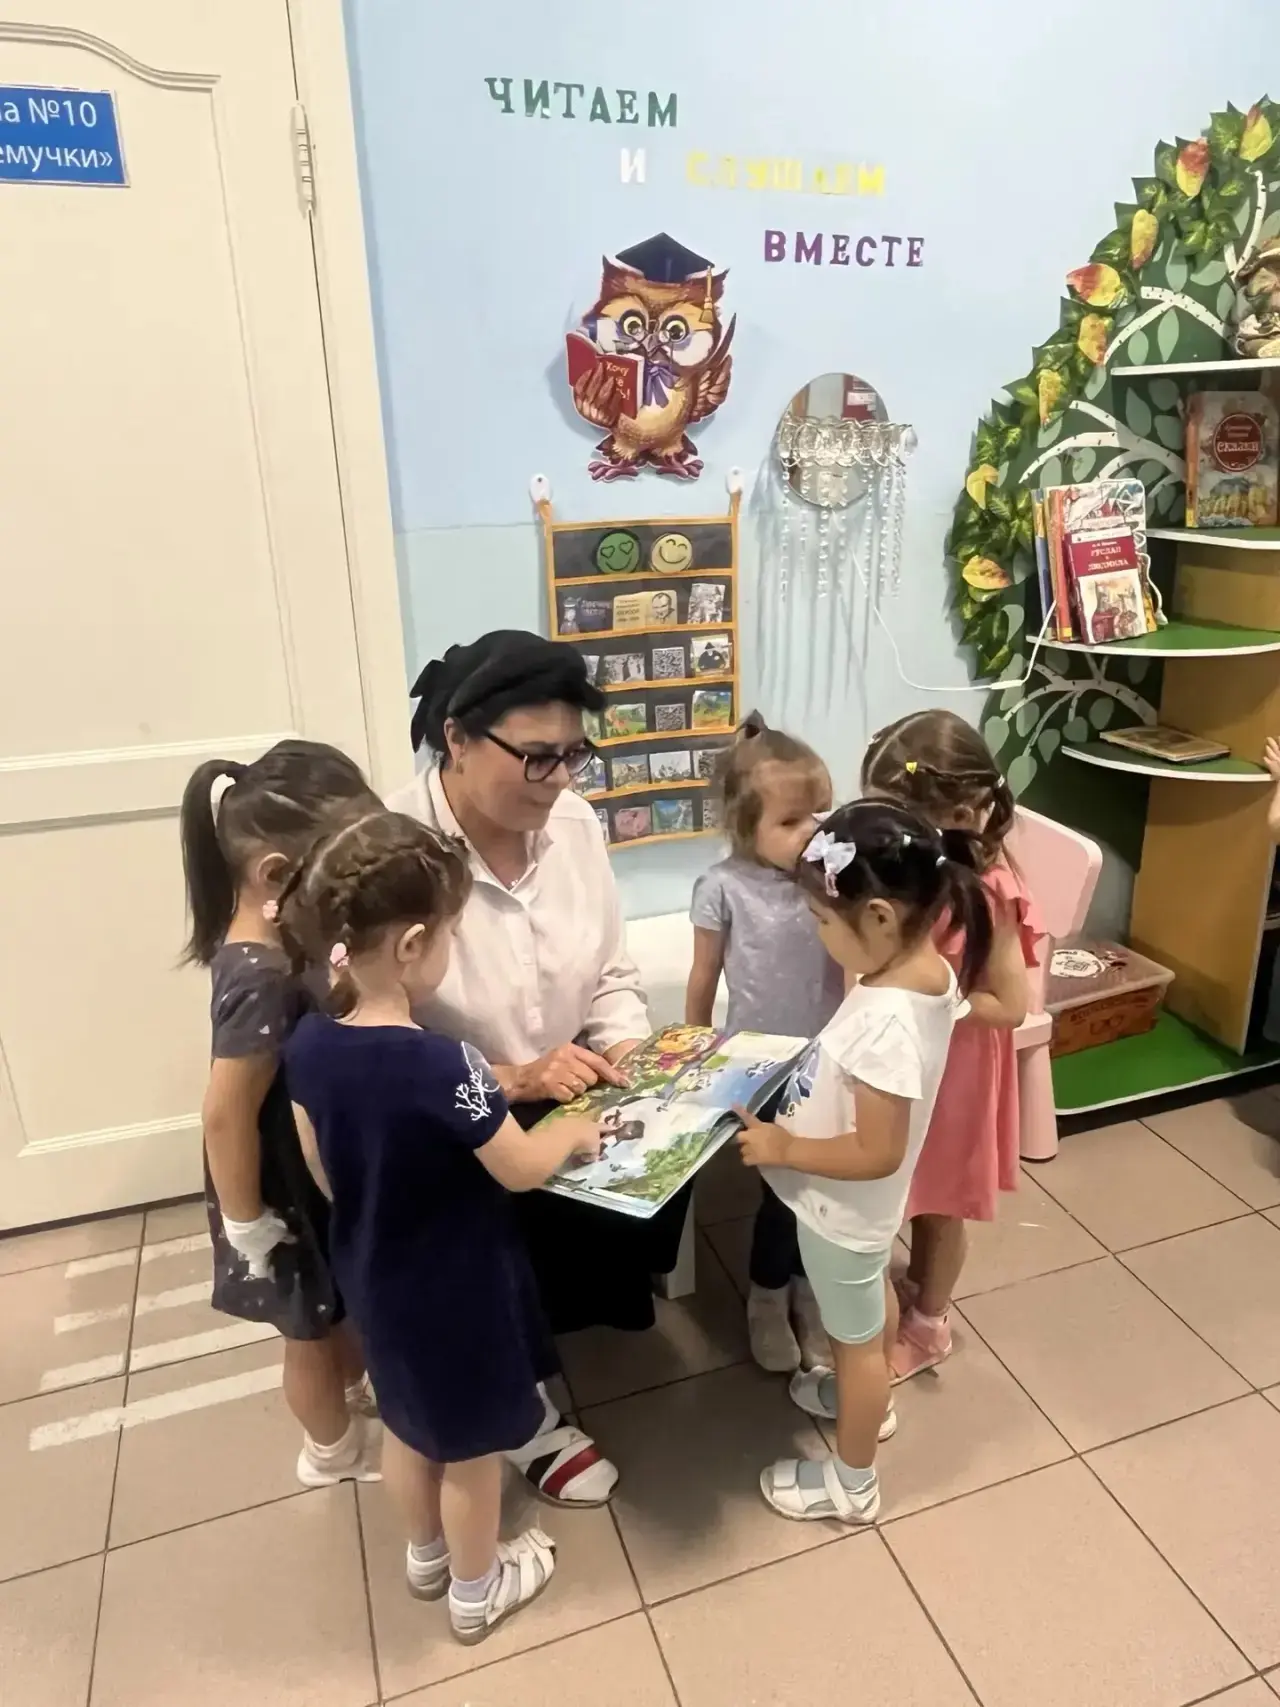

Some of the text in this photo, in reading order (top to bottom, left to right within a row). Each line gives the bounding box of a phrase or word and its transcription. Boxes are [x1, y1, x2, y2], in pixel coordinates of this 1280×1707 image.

[0, 97, 97, 128] а №10
[484, 77, 677, 128] ЧИТАЕМ
[620, 147, 646, 183] И
[764, 229, 925, 267] ВМЕСТЕ
